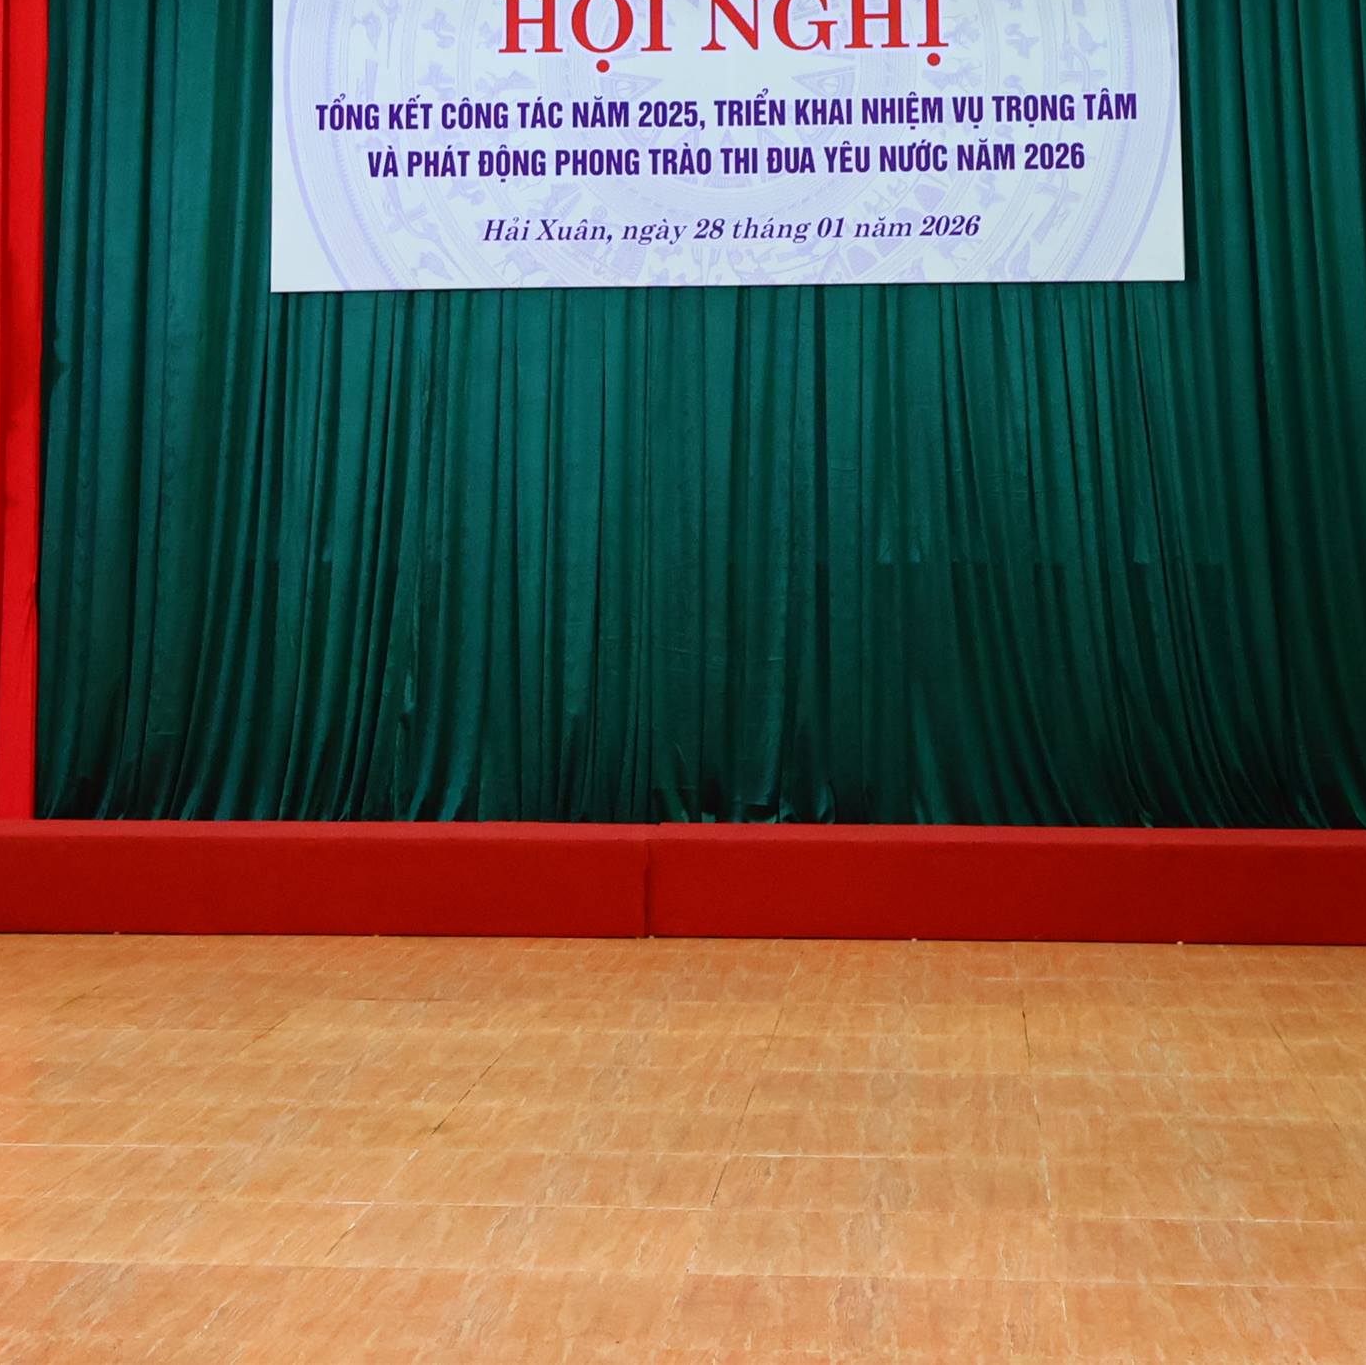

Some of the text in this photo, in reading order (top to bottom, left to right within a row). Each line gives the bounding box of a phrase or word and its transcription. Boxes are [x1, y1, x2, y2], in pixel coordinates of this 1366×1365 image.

[315, 87, 1138, 132] TỔNG KẾT CÔNG TÁC NĂM 2025, TRIỂN KHAI NHIỆM VỤ TRỌNG TÂM
[367, 137, 1086, 183] VÀ PHÁT ĐỘNG PHONG TRÀO THI ĐUA YÊU NƯỚC NĂM 2026
[482, 214, 982, 246] Hải Xuân, ngày 28 tháng 01 năm 2026
